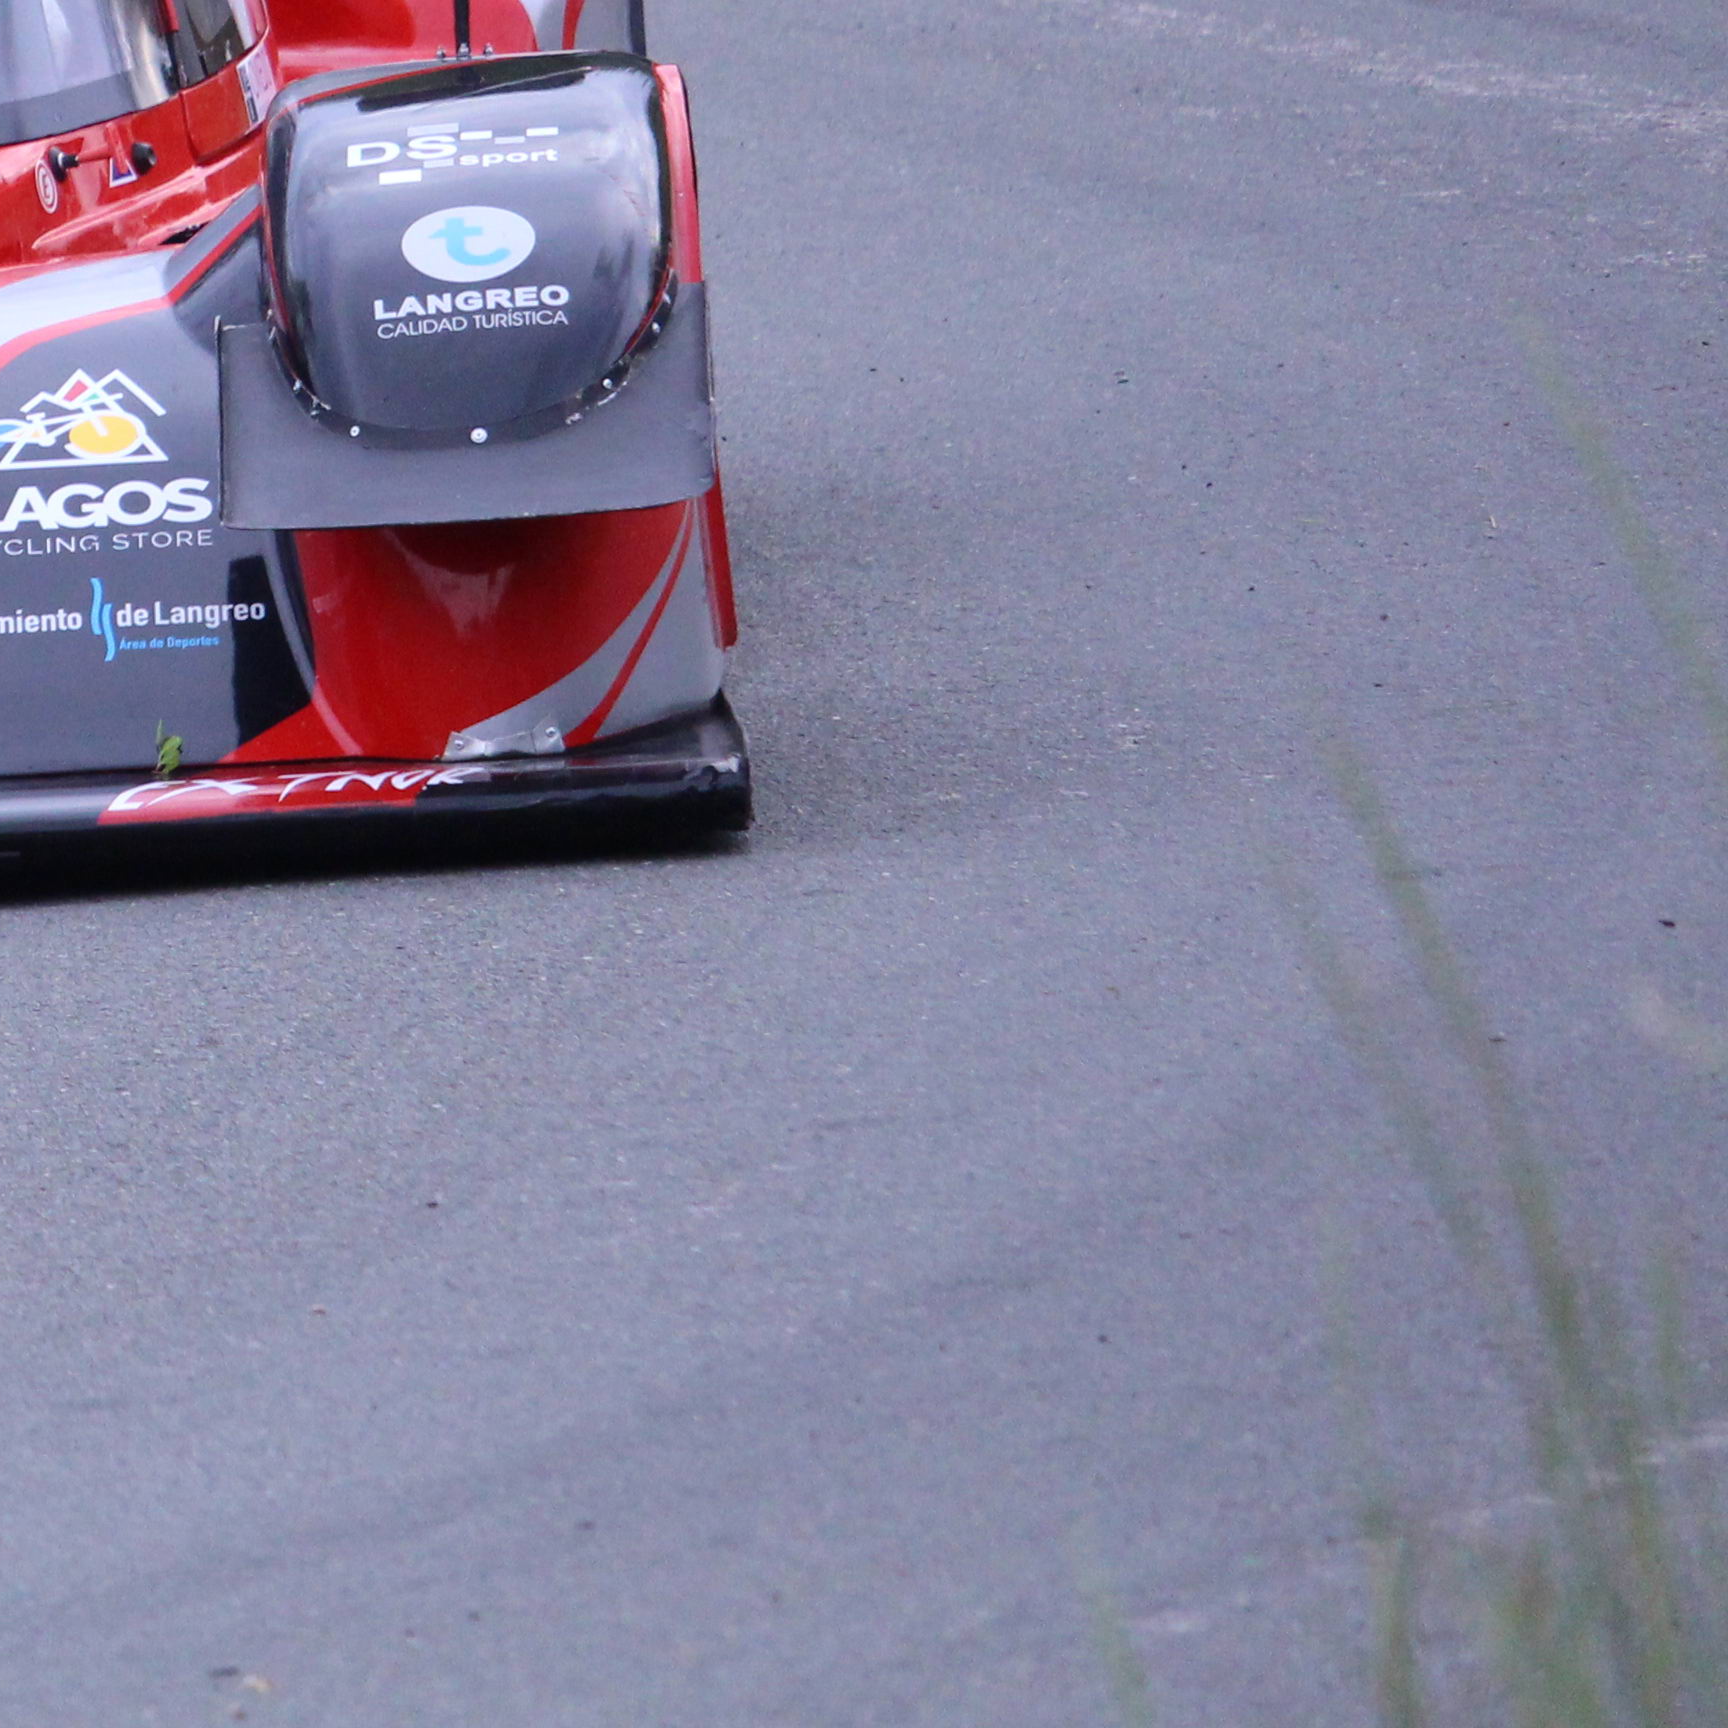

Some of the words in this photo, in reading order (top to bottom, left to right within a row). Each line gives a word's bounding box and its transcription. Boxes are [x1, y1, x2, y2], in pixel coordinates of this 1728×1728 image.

[347, 135, 458, 168] DS
[459, 148, 559, 168] sport
[374, 284, 570, 321] LANGREO
[377, 317, 468, 339] CALIDAD
[472, 309, 569, 329] TURÍSTICA
[112, 527, 215, 552] STORE
[116, 602, 149, 628] de
[153, 600, 266, 628] Langreo
[149, 637, 164, 649] de
[166, 635, 221, 649] Deportes
